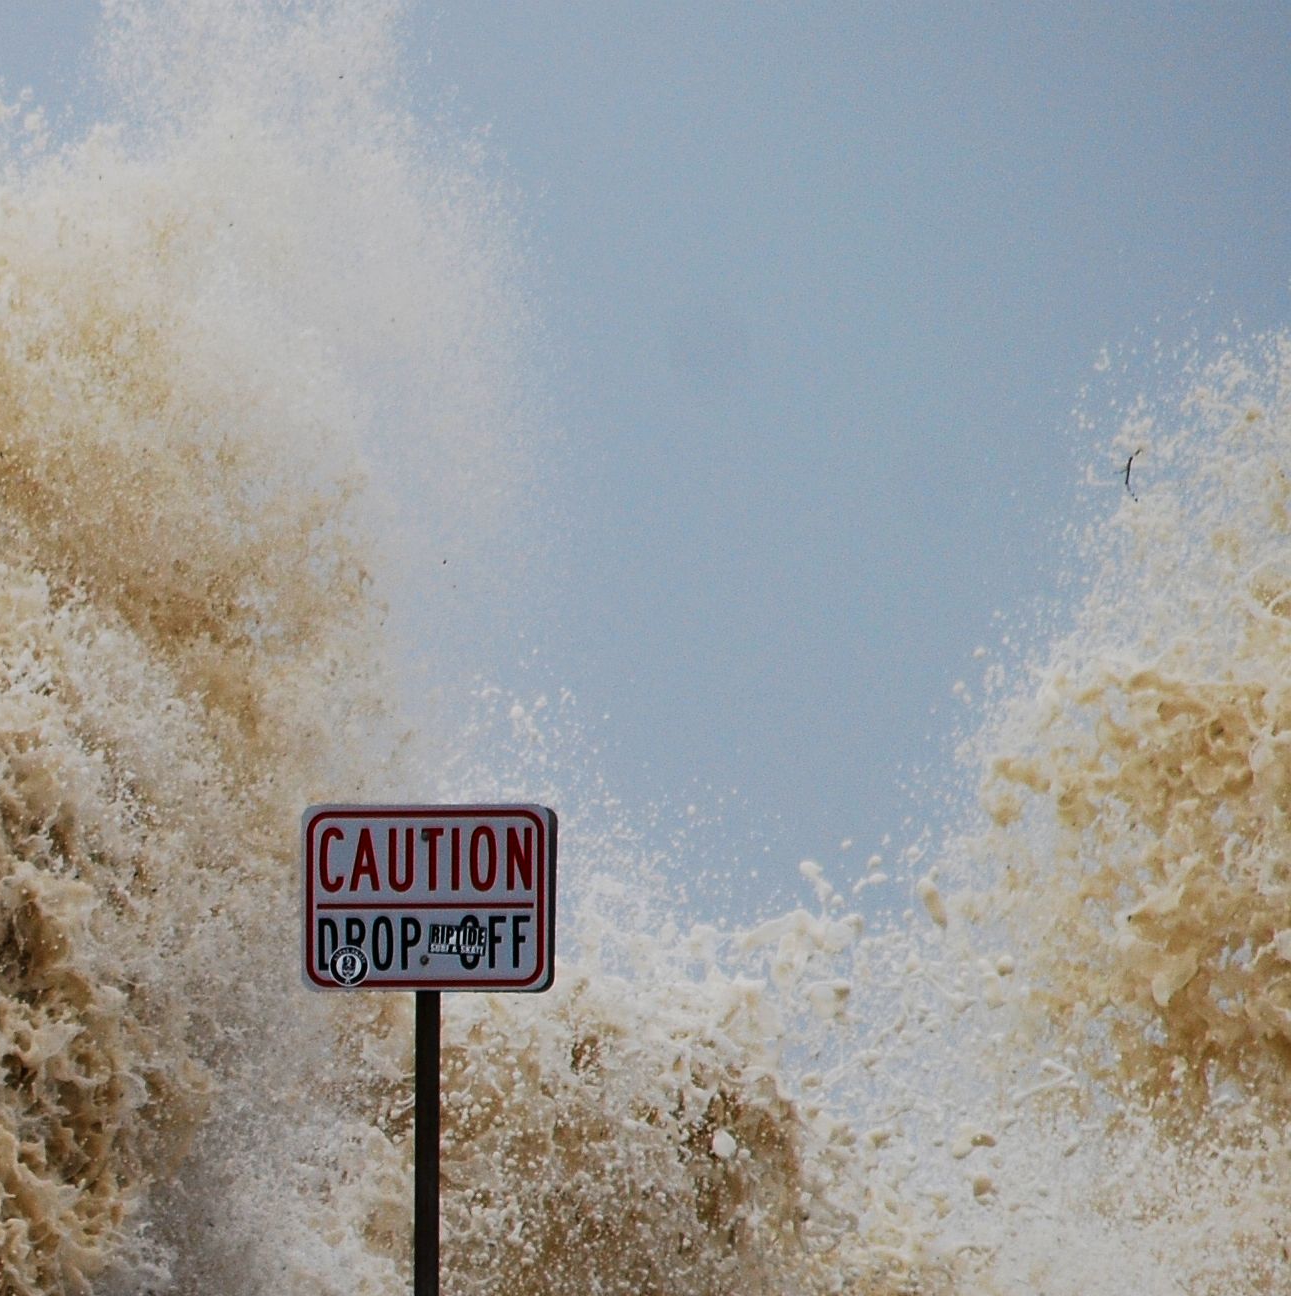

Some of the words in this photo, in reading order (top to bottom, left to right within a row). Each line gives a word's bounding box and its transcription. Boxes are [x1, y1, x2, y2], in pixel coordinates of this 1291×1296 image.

[319, 825, 533, 893] CAUTION
[318, 915, 422, 971] DROP
[459, 914, 531, 970] OFF
[431, 925, 486, 946] RIPTIDE
